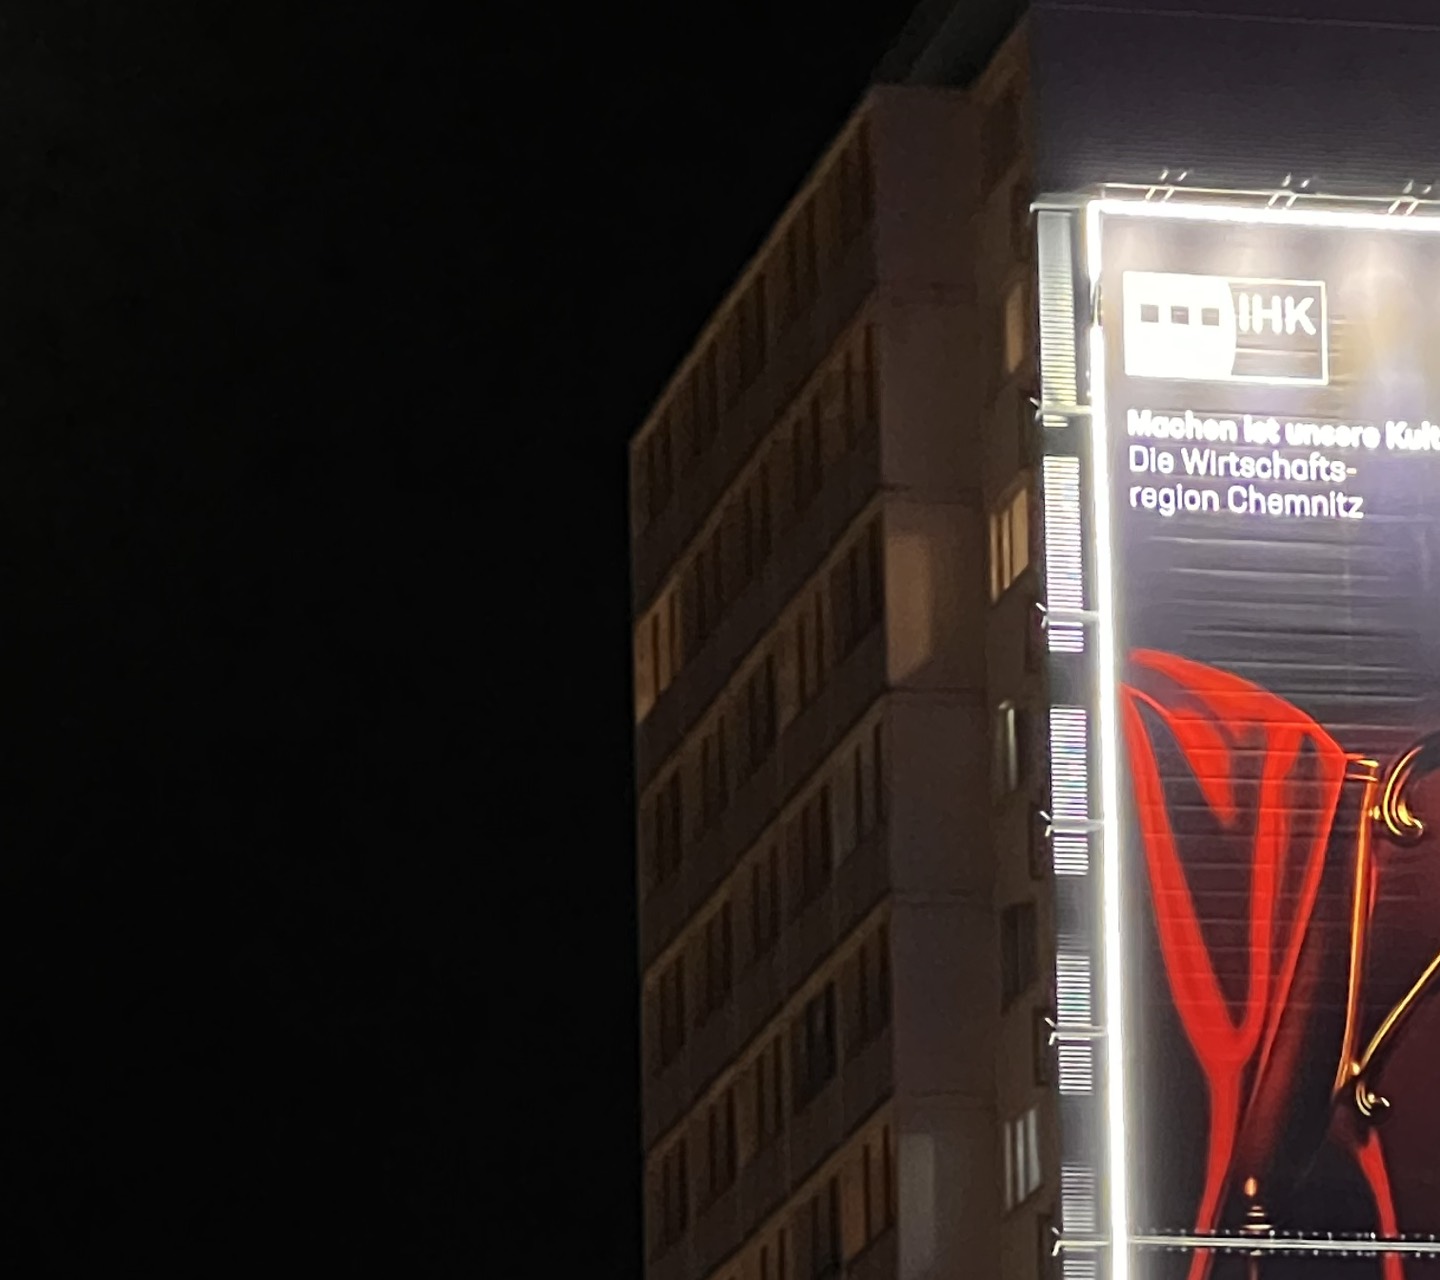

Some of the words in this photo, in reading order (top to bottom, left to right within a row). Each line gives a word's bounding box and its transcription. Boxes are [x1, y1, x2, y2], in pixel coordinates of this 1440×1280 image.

[1239, 292, 1317, 336] IHK
[1129, 445, 1174, 473] Die
[1181, 448, 1357, 482] Wirtschafts-
[1130, 483, 1219, 517] region
[1228, 484, 1364, 518] Chemnitz
